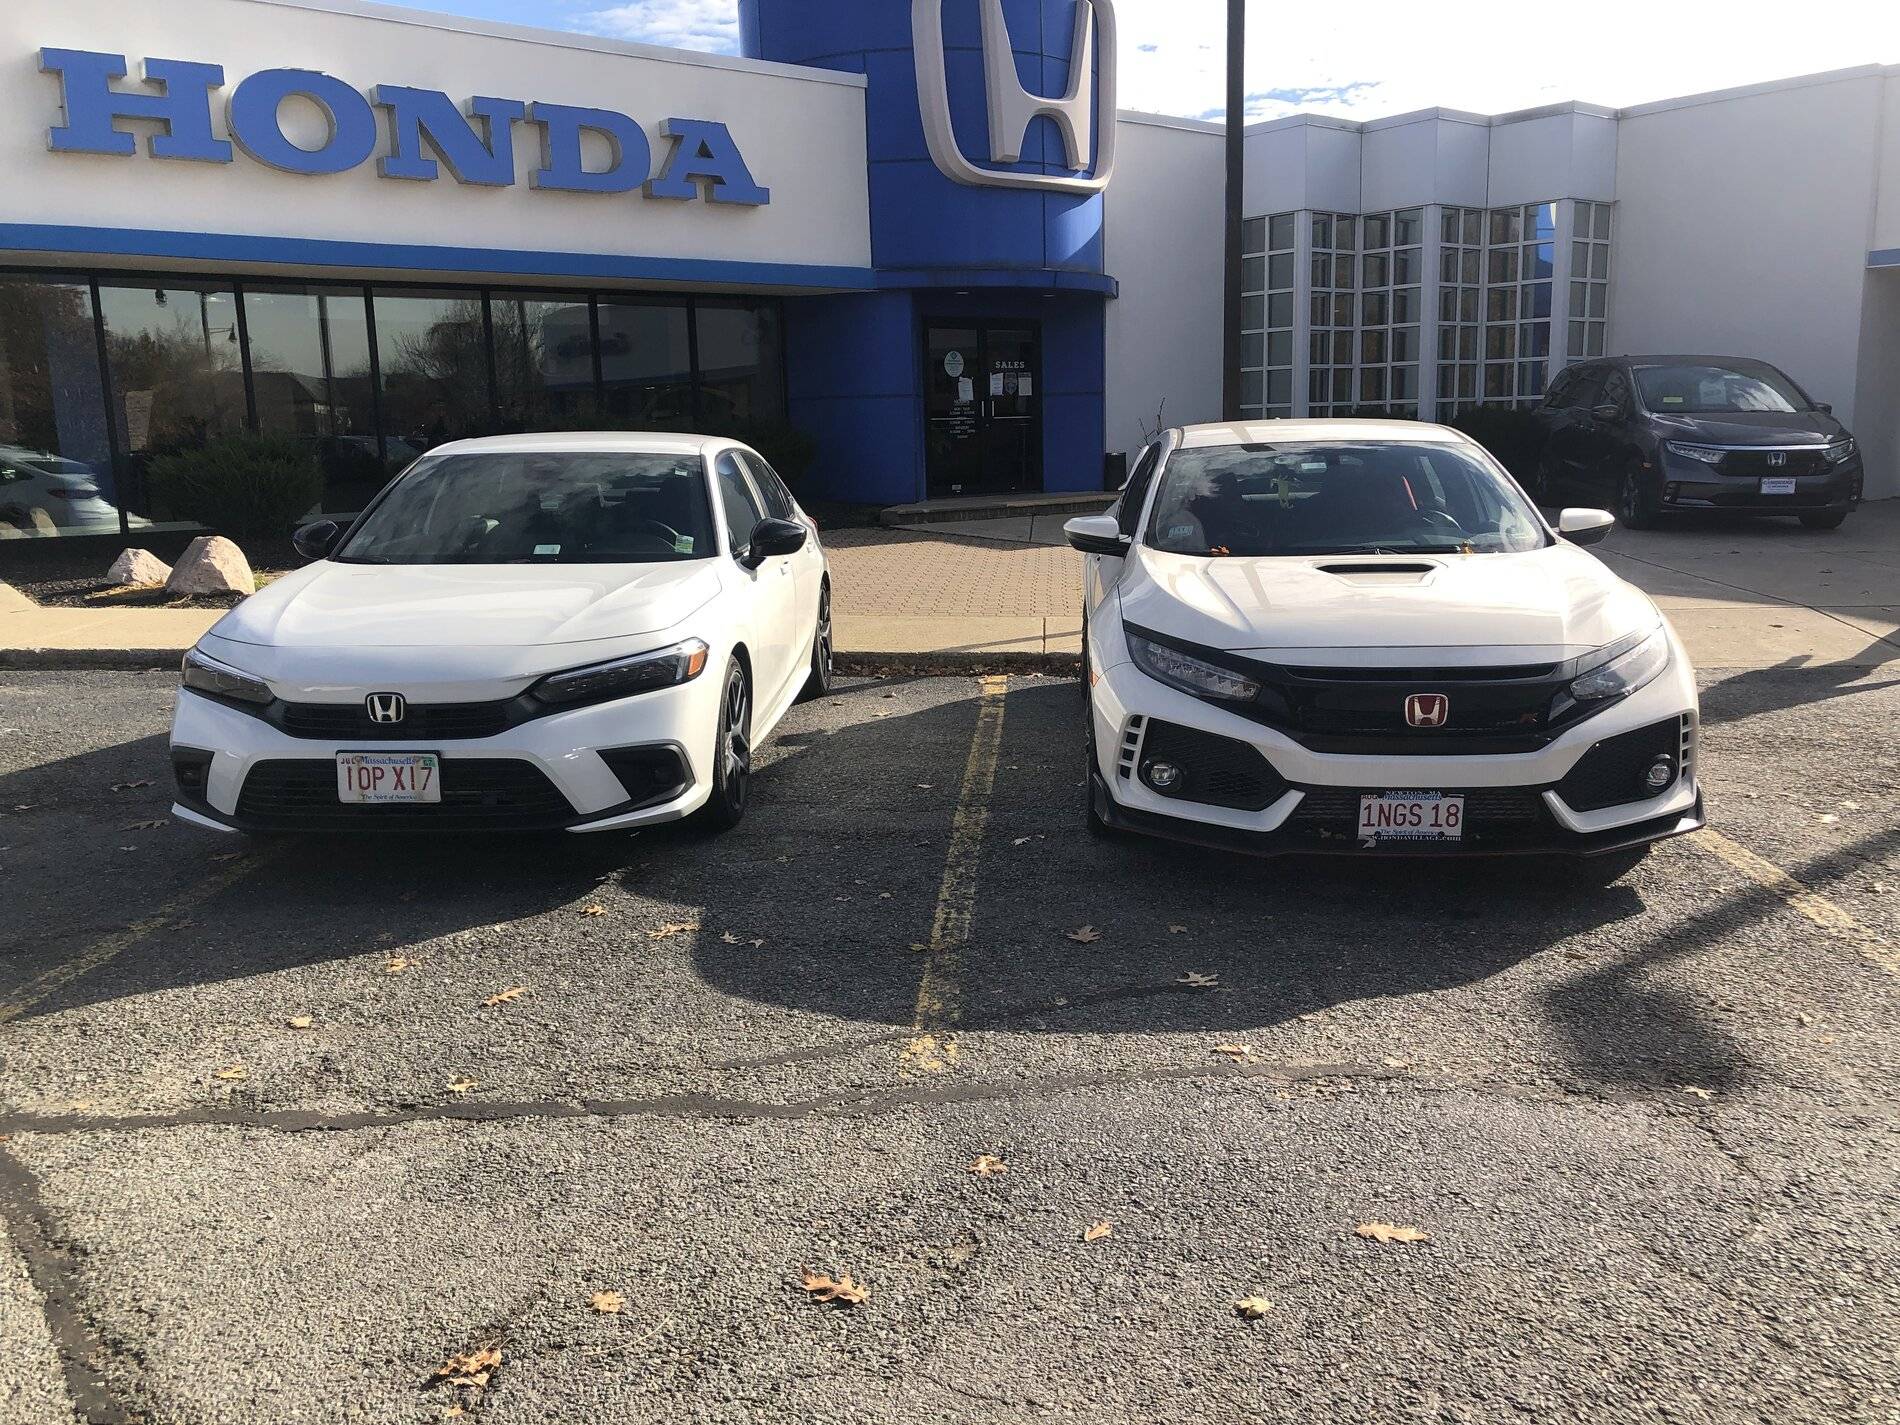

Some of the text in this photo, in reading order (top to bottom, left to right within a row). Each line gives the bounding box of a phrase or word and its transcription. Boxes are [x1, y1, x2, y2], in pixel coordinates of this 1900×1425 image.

[39, 47, 770, 206] HONDA
[995, 361, 1025, 369] SALES
[360, 756, 417, 766] Massachusetts
[373, 793, 388, 801] Spirit
[1362, 803, 1460, 828] 1NGS 18
